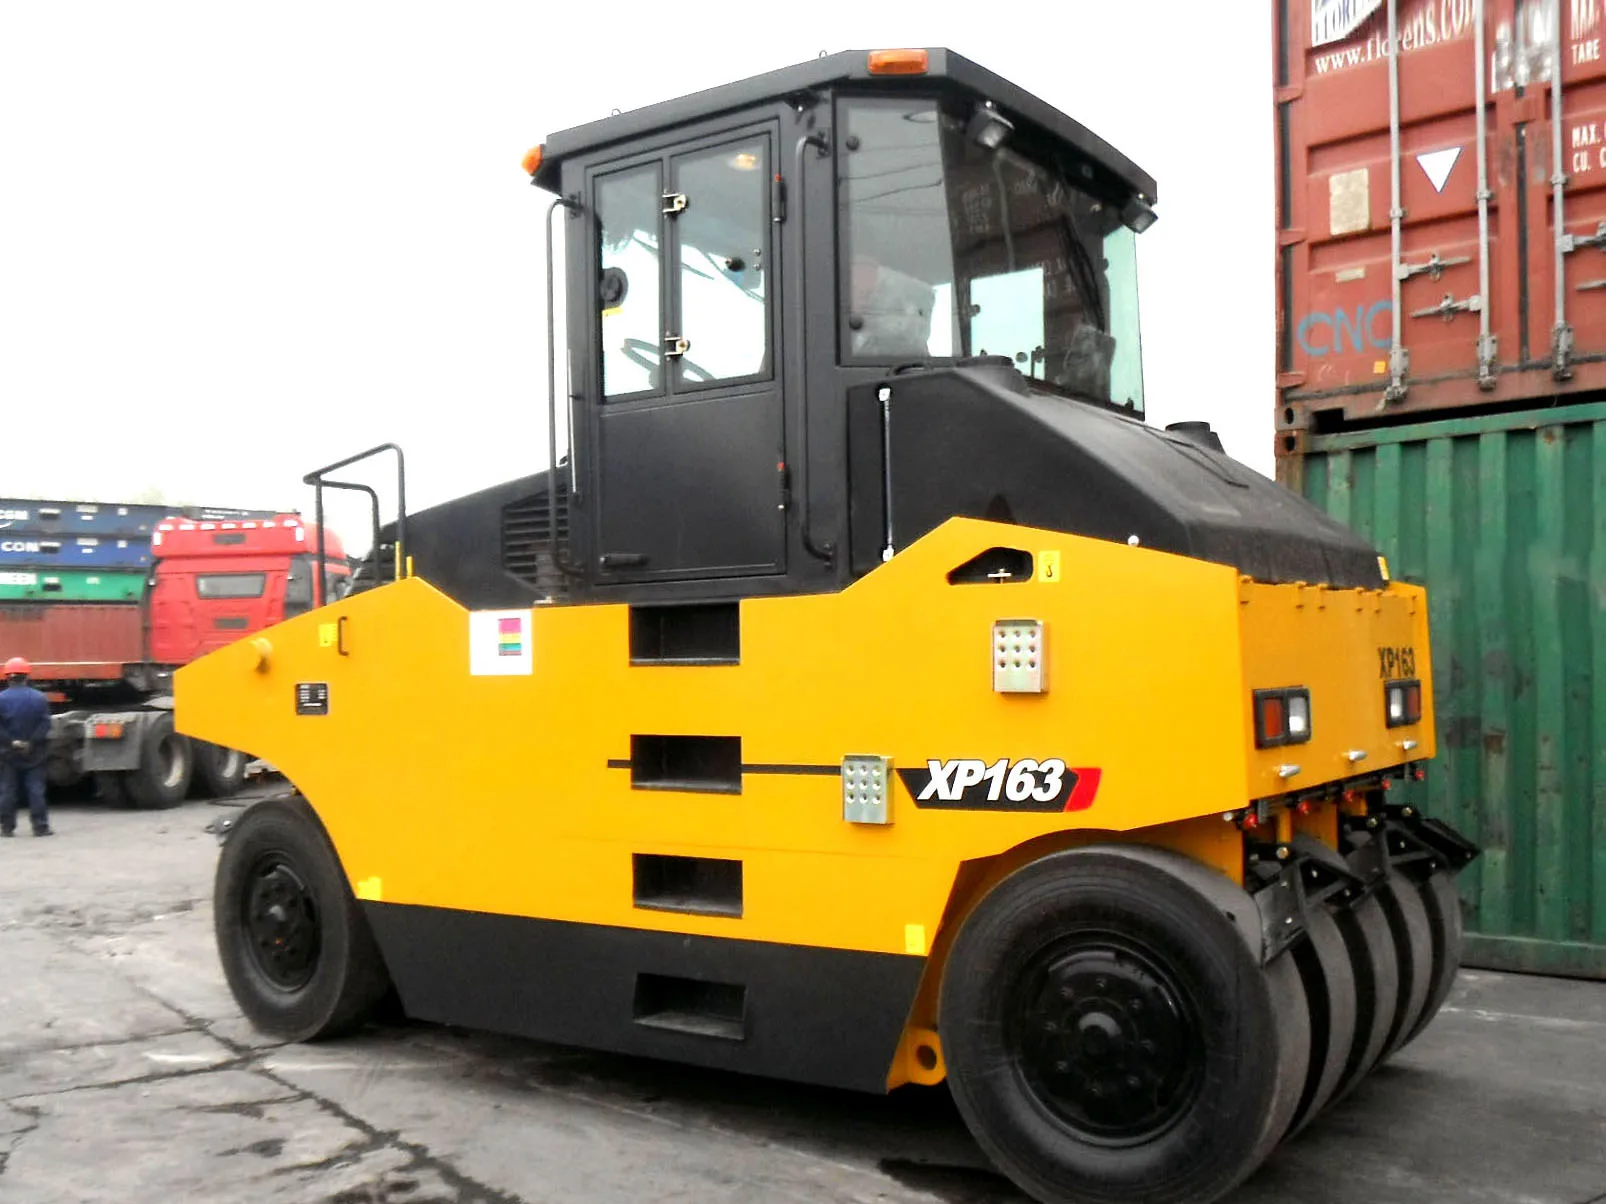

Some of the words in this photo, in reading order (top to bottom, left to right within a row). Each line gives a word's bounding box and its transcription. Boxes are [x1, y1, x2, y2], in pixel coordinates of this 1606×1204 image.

[1315, 0, 1476, 74] www.floens.co
[1571, 39, 1600, 65] TARE
[1377, 647, 1415, 679] XP163
[916, 758, 1065, 802] XP163
